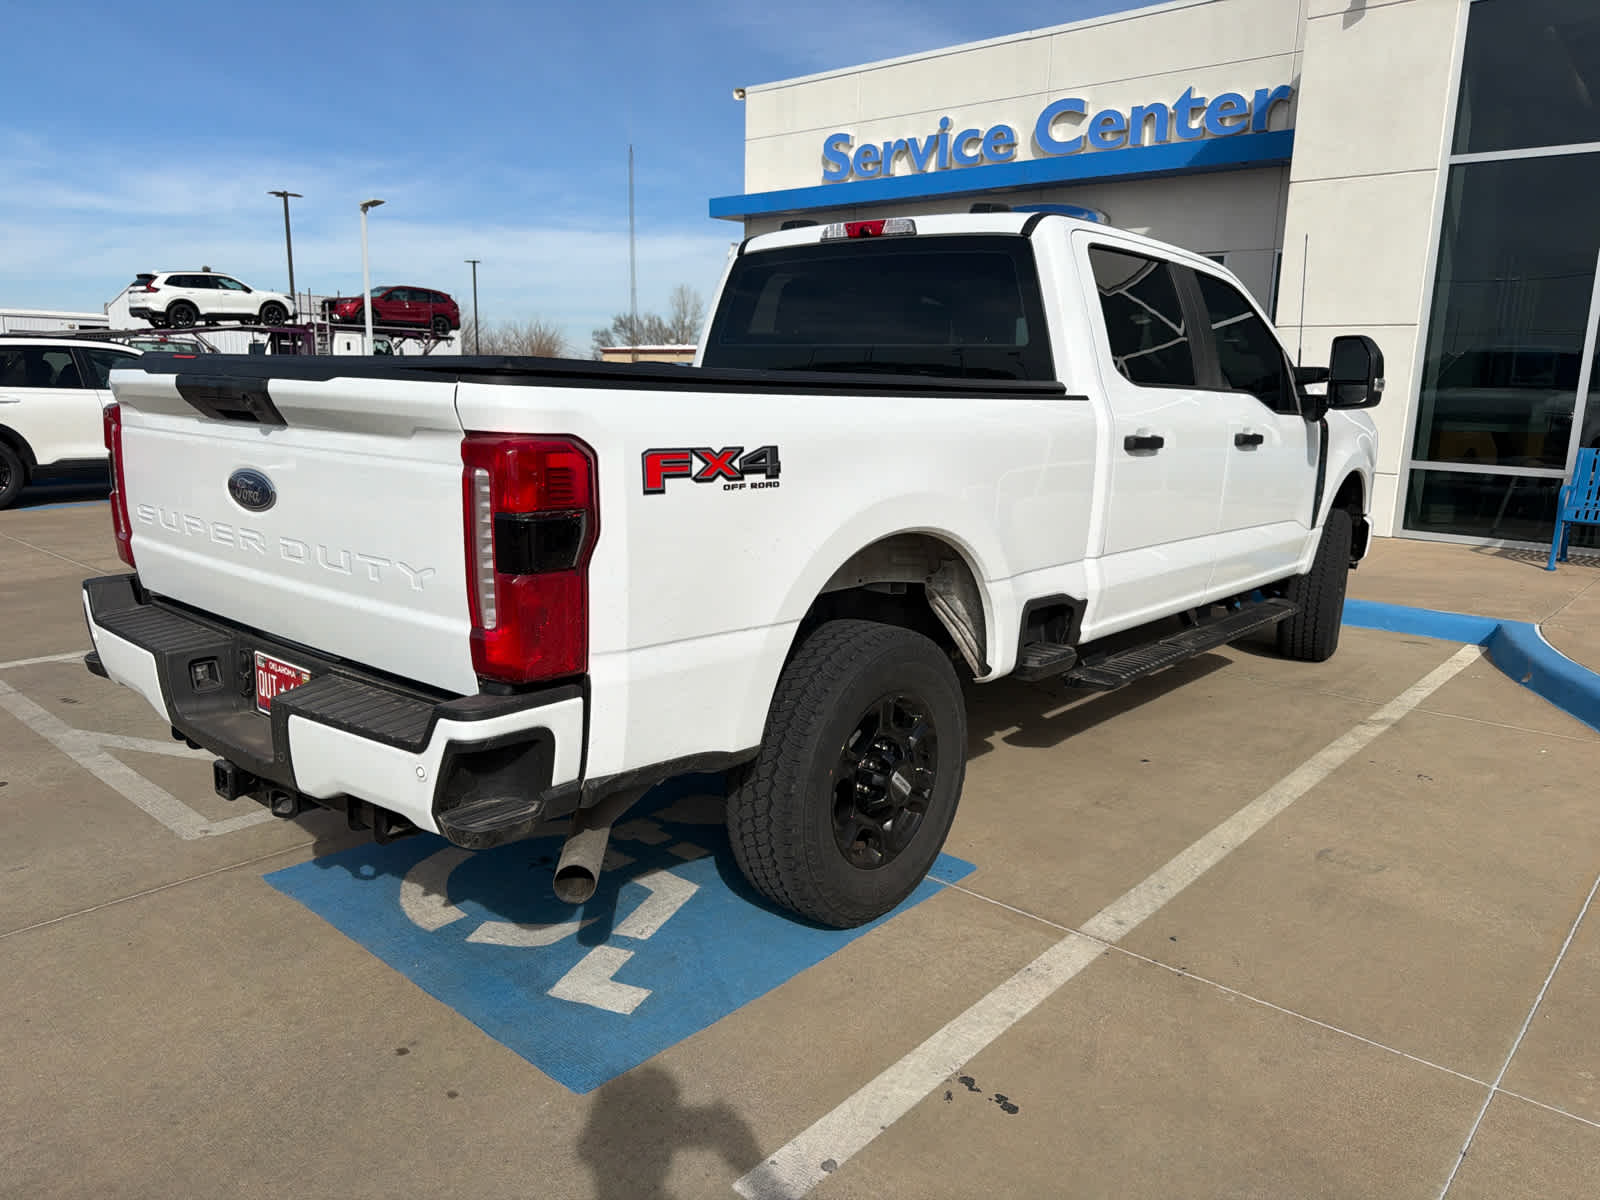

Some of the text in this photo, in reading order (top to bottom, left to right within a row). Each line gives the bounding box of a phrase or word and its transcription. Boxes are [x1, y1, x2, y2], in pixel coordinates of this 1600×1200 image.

[820, 84, 1296, 184] Service Center
[641, 445, 781, 495] FX4
[723, 481, 780, 491] OFF ROAD
[235, 477, 266, 504] Ford
[136, 503, 436, 592] SUPER DUTY
[268, 661, 297, 679] OKLAHOMA
